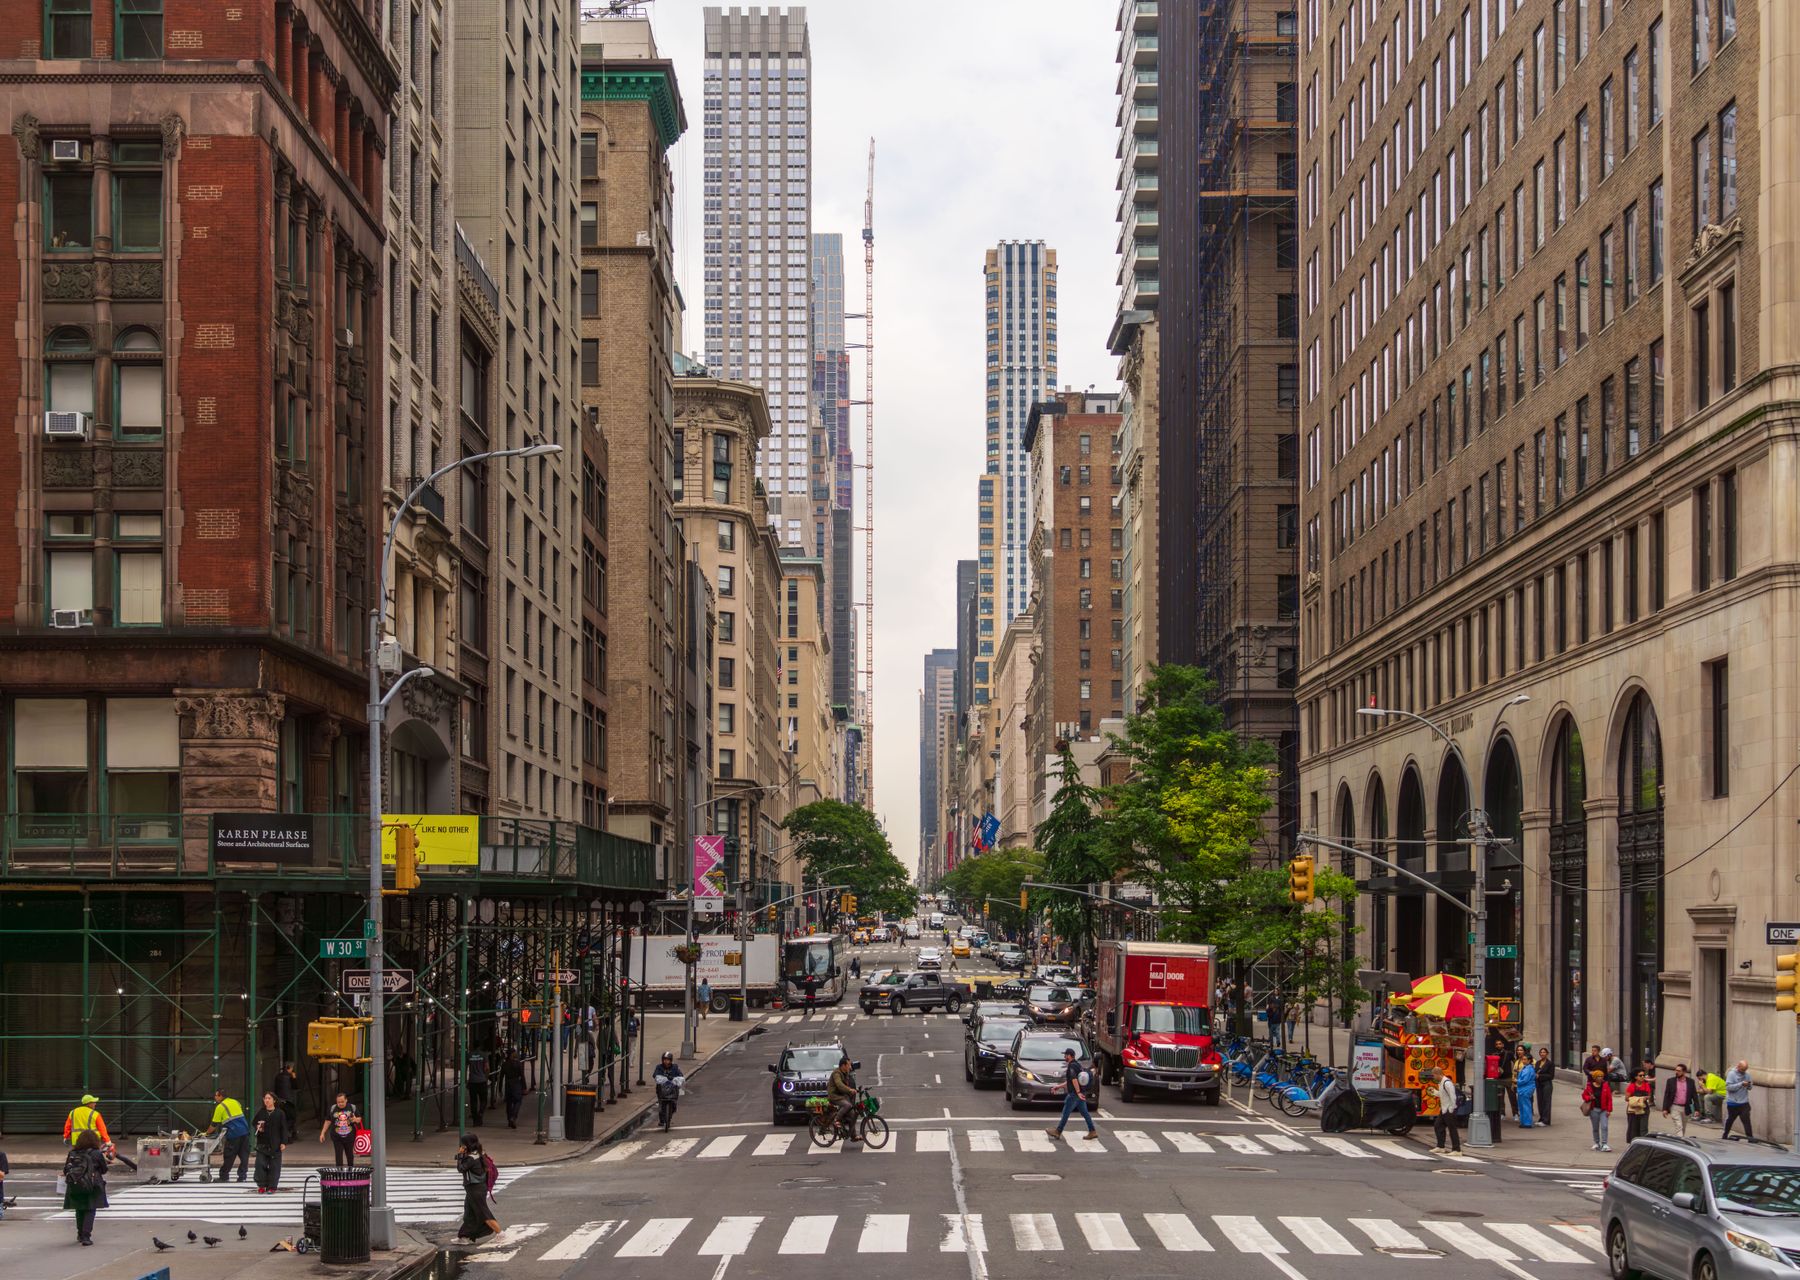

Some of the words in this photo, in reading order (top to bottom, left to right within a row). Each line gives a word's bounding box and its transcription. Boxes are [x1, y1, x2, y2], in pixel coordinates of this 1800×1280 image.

[218, 829, 259, 839] KAREN
[262, 830, 308, 840] PEARSE
[449, 826, 469, 834] OTHER
[247, 840, 285, 848] Architectural
[700, 876, 720, 897] NOMAD
[1772, 929, 1795, 938] ONE
[326, 941, 335, 955] W
[338, 941, 352, 955] 30
[355, 941, 362, 949] St
[1490, 947, 1495, 956] E
[1496, 947, 1506, 956] 30
[1166, 972, 1185, 980] DOOR
[351, 977, 370, 987] ONE
